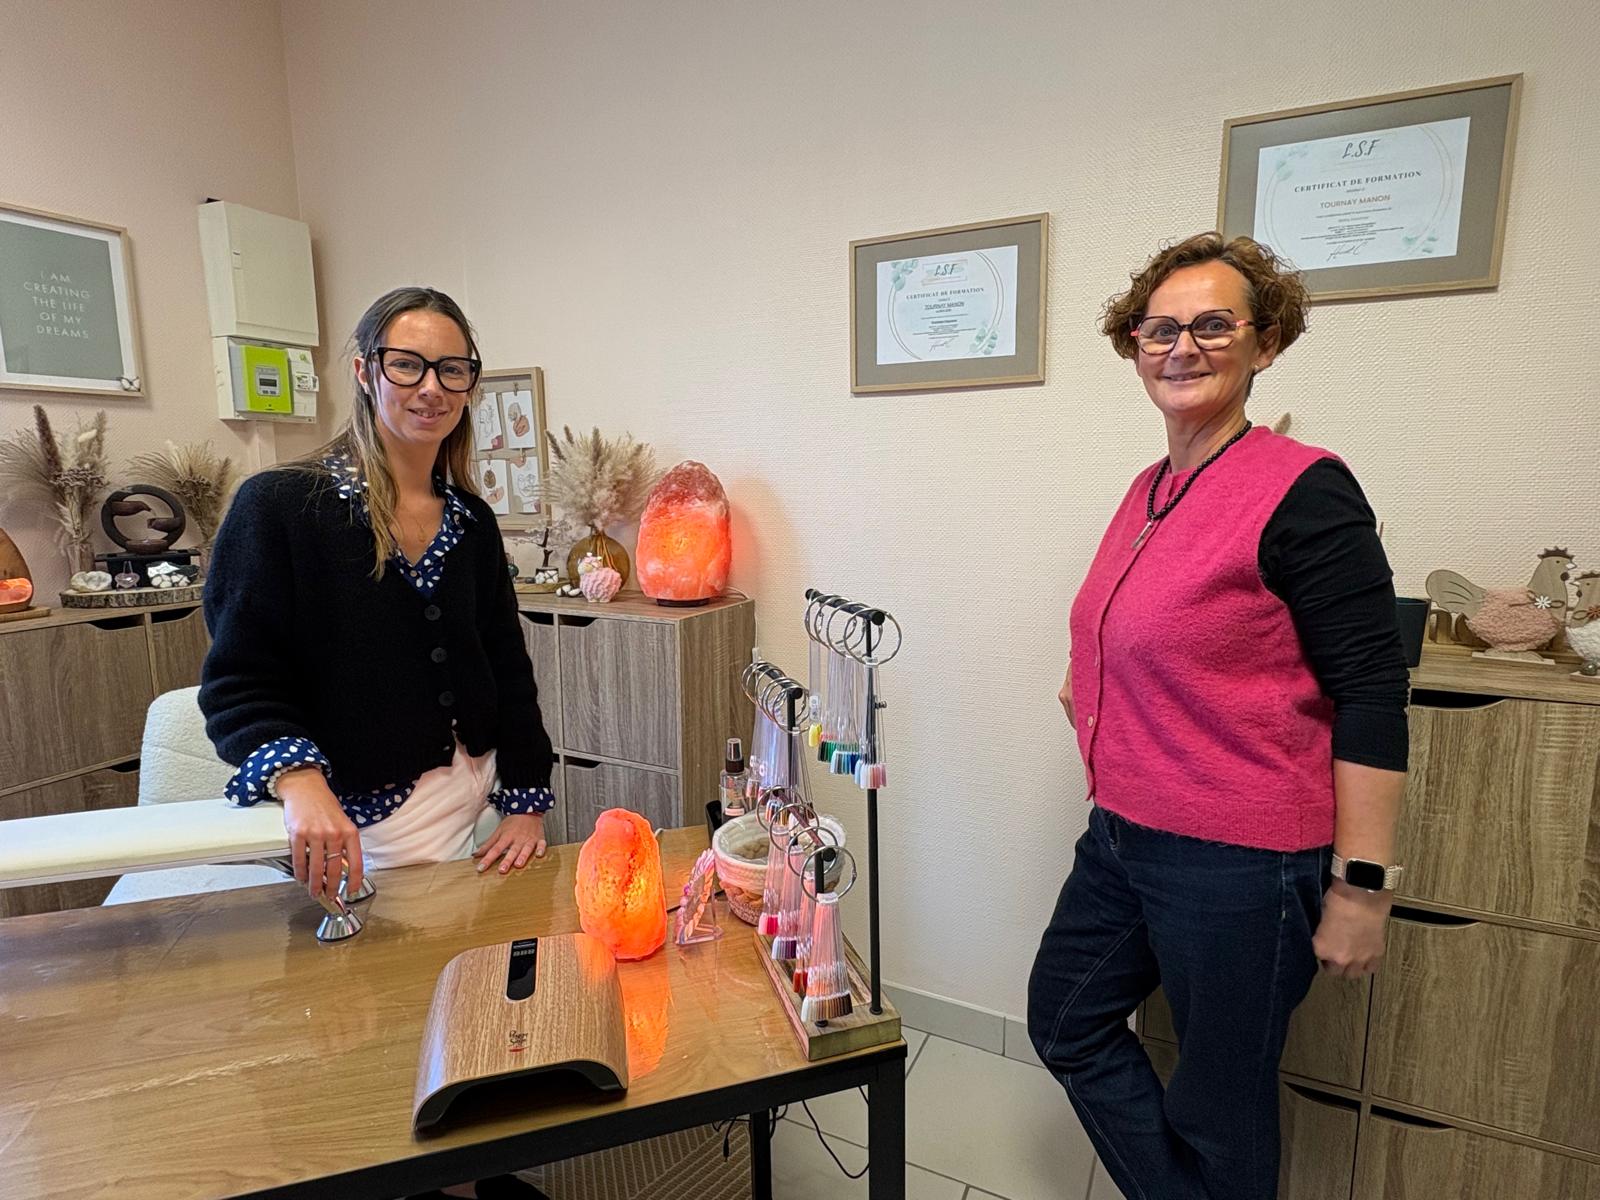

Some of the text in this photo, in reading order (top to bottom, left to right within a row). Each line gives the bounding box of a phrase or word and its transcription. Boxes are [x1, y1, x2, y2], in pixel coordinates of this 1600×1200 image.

[1294, 180, 1348, 193] CERTIFICAT
[1350, 178, 1363, 186] DE
[1365, 170, 1422, 184] FORMATION
[1320, 194, 1391, 209] TOURNAY MANON
[50, 272, 71, 283] AM
[23, 281, 90, 299] CREATING
[906, 292, 939, 300] CERTIFICAT
[949, 287, 984, 295] FORMATION
[32, 296, 57, 309] THE
[40, 311, 81, 324] OF MY
[36, 325, 89, 339] DREAMS
